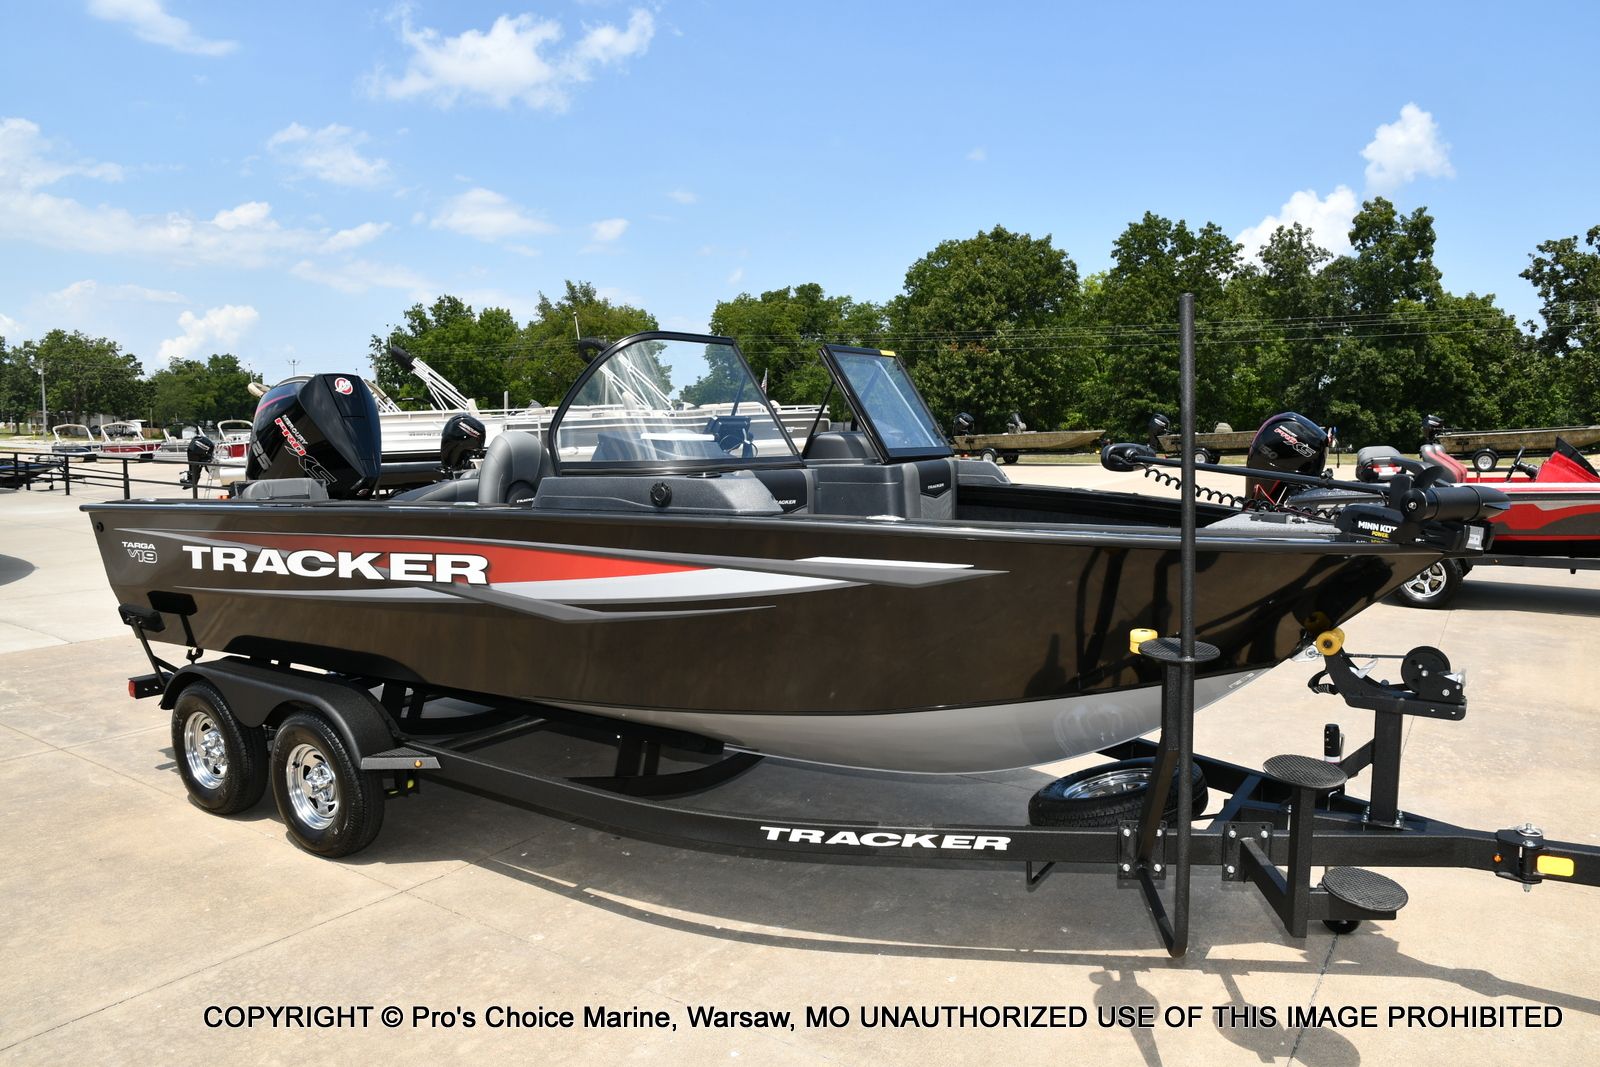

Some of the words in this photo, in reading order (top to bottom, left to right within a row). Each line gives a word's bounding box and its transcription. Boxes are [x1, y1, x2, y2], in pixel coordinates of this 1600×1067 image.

[274, 417, 306, 456] PRO
[281, 414, 309, 445] MERCURY
[1358, 520, 1380, 531] MINN
[1379, 524, 1398, 534] KOT
[121, 541, 156, 550] TARGA
[127, 548, 158, 564] V19
[182, 545, 489, 585] TRACKER
[760, 826, 1011, 851] TRACKER
